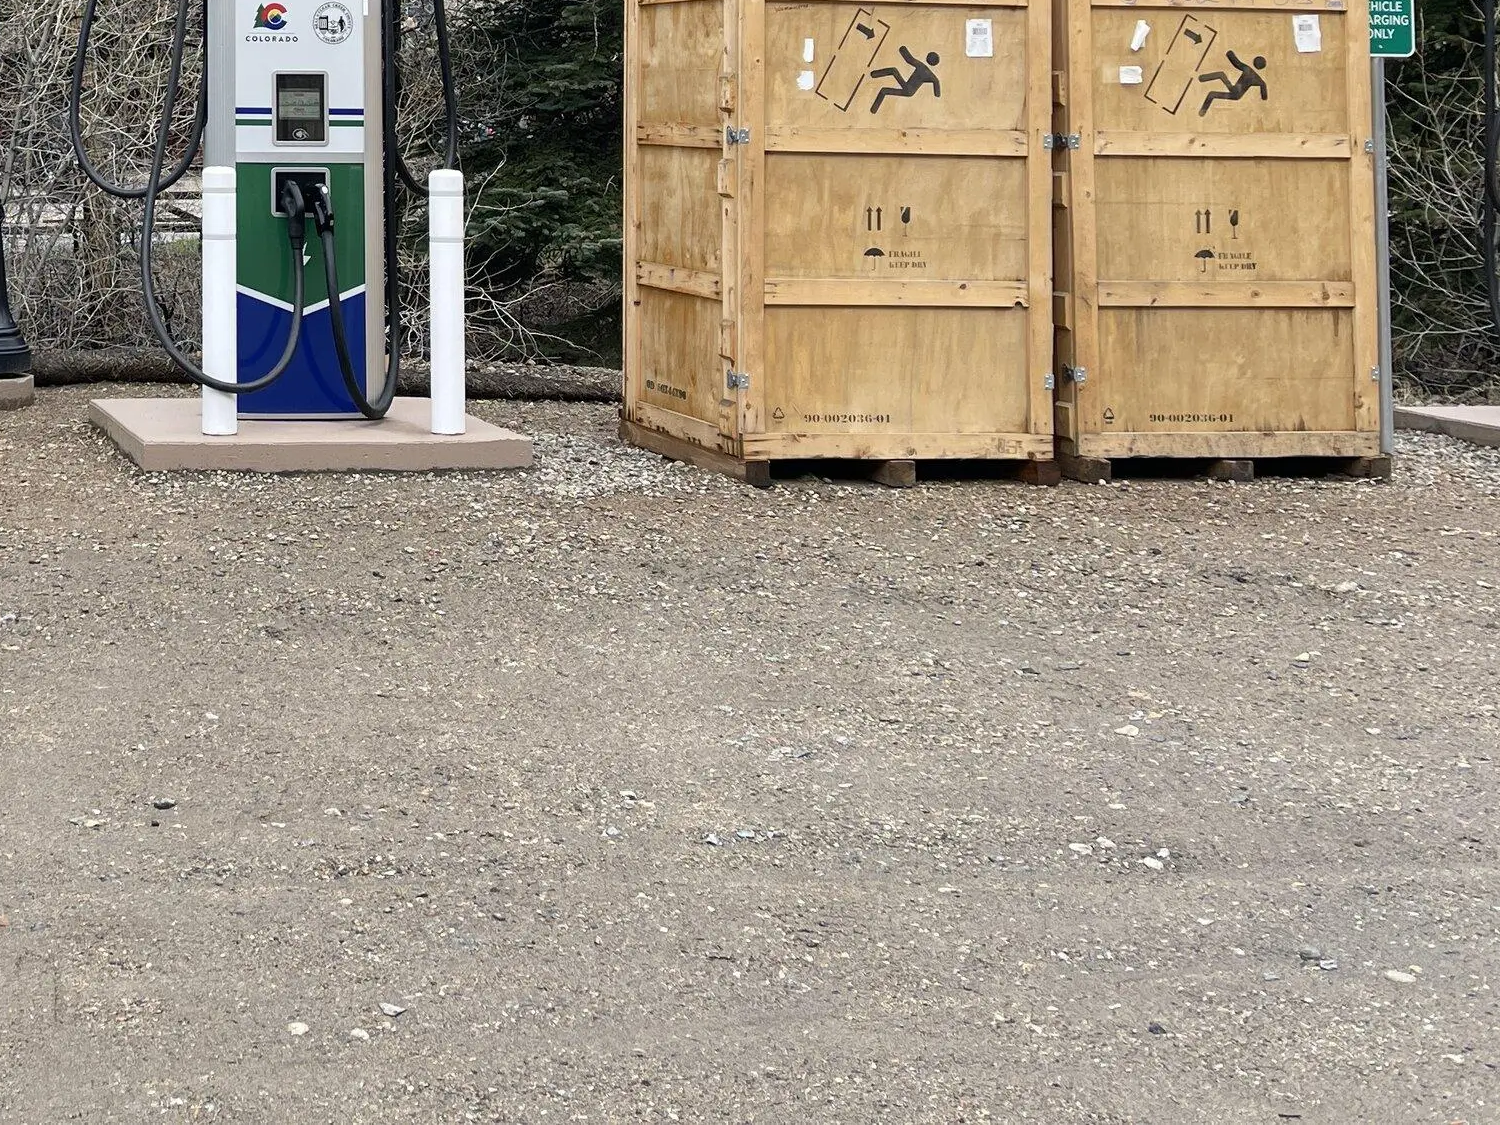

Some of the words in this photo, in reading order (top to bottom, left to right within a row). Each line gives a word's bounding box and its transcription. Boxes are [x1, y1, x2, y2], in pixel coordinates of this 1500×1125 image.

[1370, 0, 1403, 12] HICLE
[1369, 14, 1409, 26] ARGING
[245, 35, 299, 43] COLORADO
[1241, 262, 1257, 270] DRY
[804, 414, 891, 424] 90-002036-01
[1149, 413, 1235, 423] 90-002036-01
